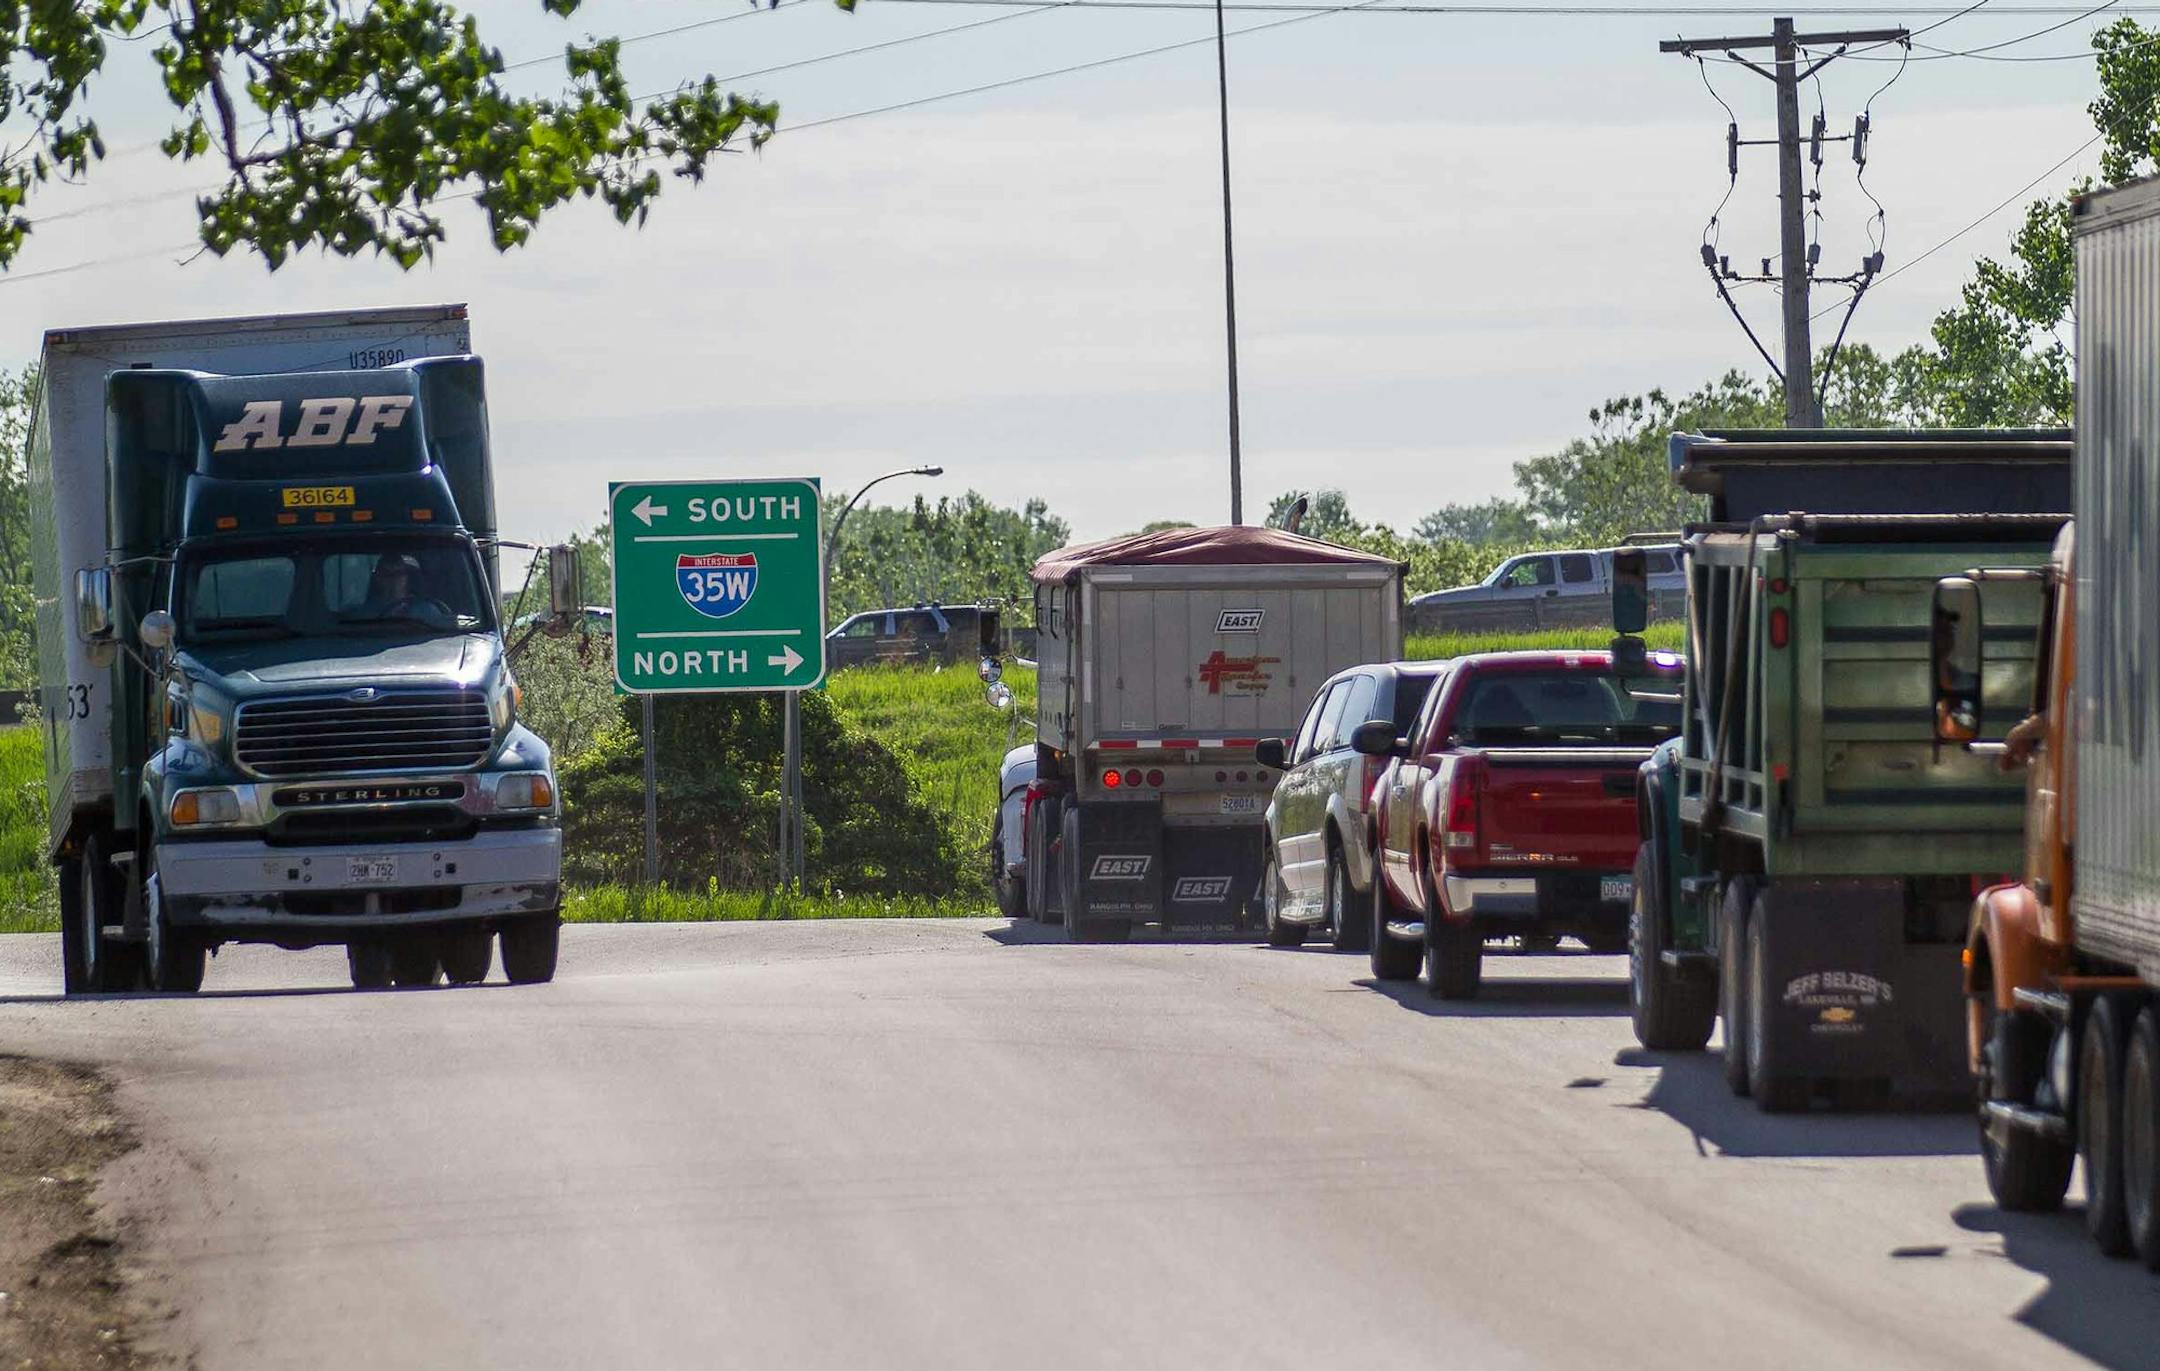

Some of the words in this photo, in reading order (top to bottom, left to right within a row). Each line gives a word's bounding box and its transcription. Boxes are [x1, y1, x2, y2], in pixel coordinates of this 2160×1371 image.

[214, 395, 414, 452] ABF
[290, 488, 348, 505] 36164
[687, 496, 800, 522] SOUTH
[694, 556, 739, 567] INTERSTATE
[685, 571, 749, 602] 35W
[1223, 616, 1257, 627] EAST
[633, 649, 748, 676] NORTH
[298, 786, 440, 802] STERLING
[1099, 861, 1143, 873] EAST
[1181, 882, 1224, 895] EAST
[1783, 973, 1820, 1001] JEFF
